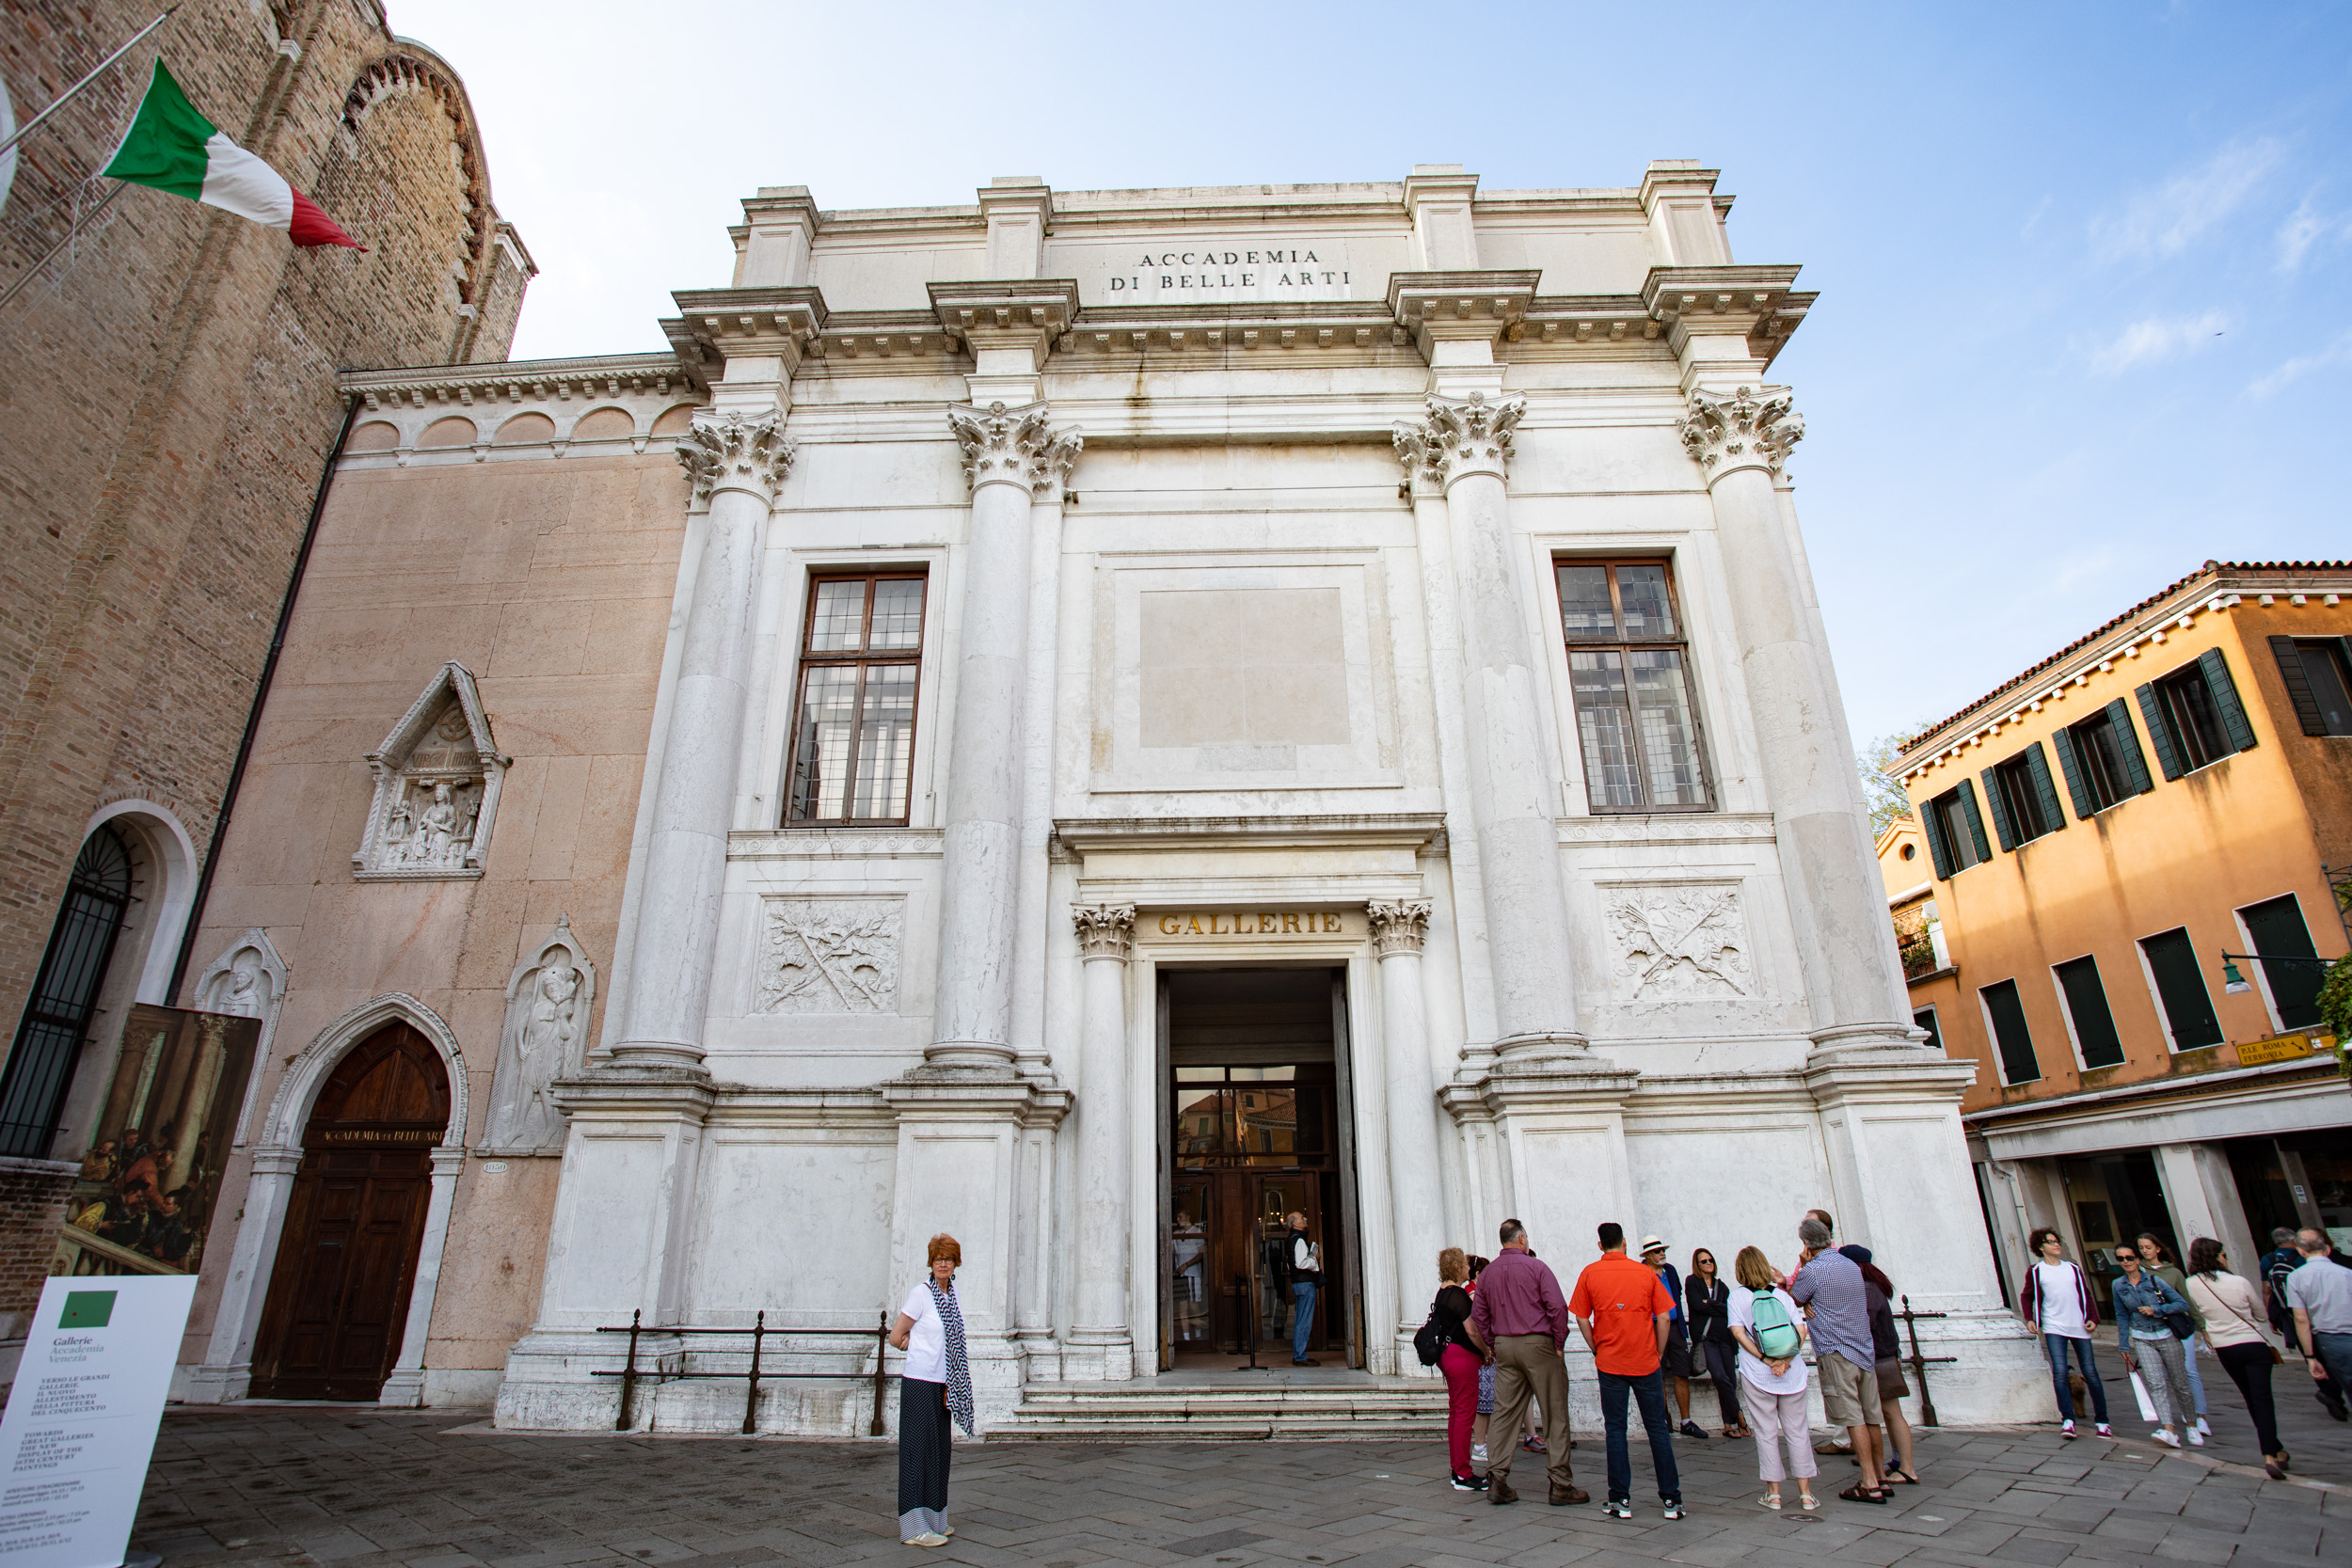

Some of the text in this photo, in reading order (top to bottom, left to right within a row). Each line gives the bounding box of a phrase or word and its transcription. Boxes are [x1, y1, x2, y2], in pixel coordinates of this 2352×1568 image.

[1139, 250, 1319, 267] ACCADEMIA
[1110, 271, 1351, 291] DI BELLE ARTI
[1159, 912, 1342, 935] GALLERIE
[2241, 1041, 2287, 1053] P.LE ROMA
[2244, 1051, 2284, 1063] FERROVIA
[323, 1131, 379, 1141] ACCADEMIA
[394, 1131, 421, 1141] BELLE
[53, 1337, 93, 1346] Gallerie
[50, 1345, 104, 1354] Accademia
[49, 1354, 87, 1363] Venezia
[80, 1373, 110, 1382] GRANDI
[34, 1393, 97, 1403] ALLESTIMENTO
[49, 1405, 106, 1415] CINQUECENTO
[24, 1430, 64, 1438] TOWARDS
[21, 1437, 49, 1446] GREAT
[17, 1449, 52, 1459] DISPLAY
[37, 1453, 76, 1463] CENTURY
[12, 1462, 58, 1472] PAINTINGS
